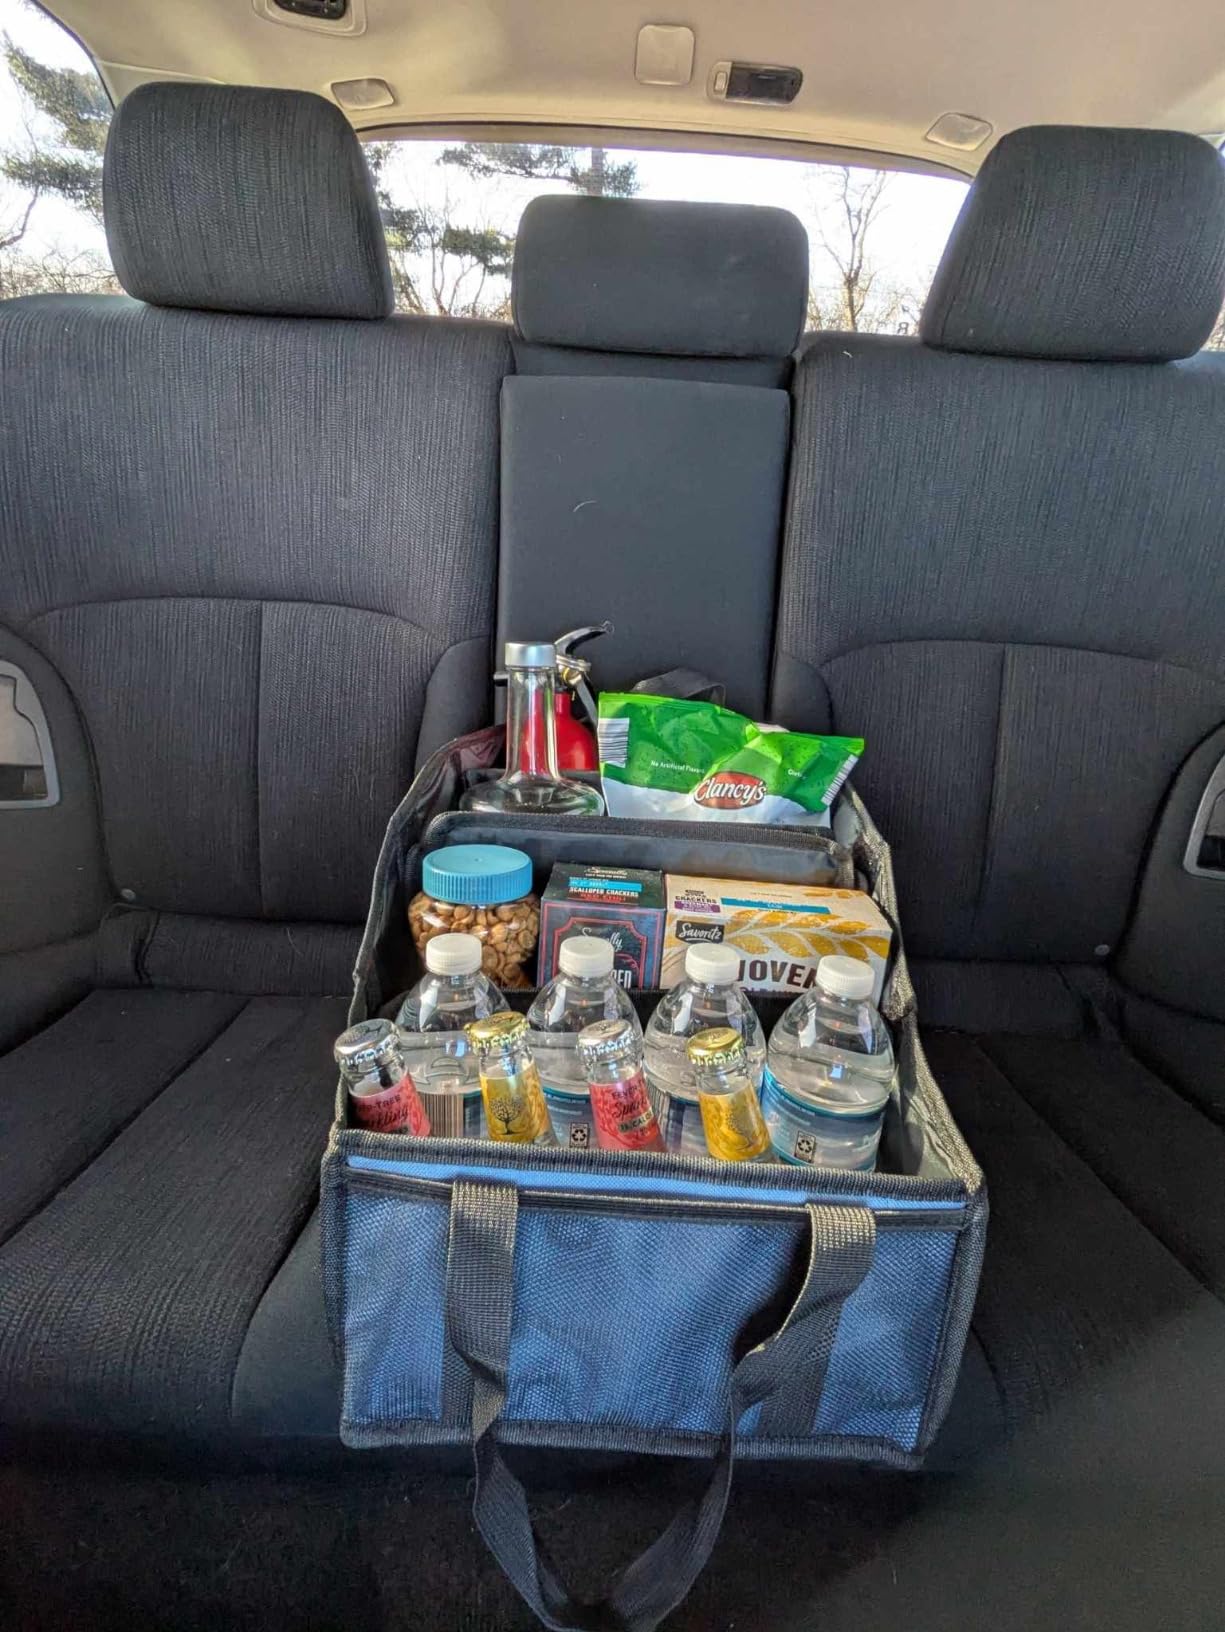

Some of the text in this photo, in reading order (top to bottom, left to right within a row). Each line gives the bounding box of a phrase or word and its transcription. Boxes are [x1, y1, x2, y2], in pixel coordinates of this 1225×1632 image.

[693, 777, 767, 806] Clancy's
[675, 895, 718, 904] CRACKERS
[679, 922, 723, 940] Savoritz
[737, 959, 817, 989] OVEN
